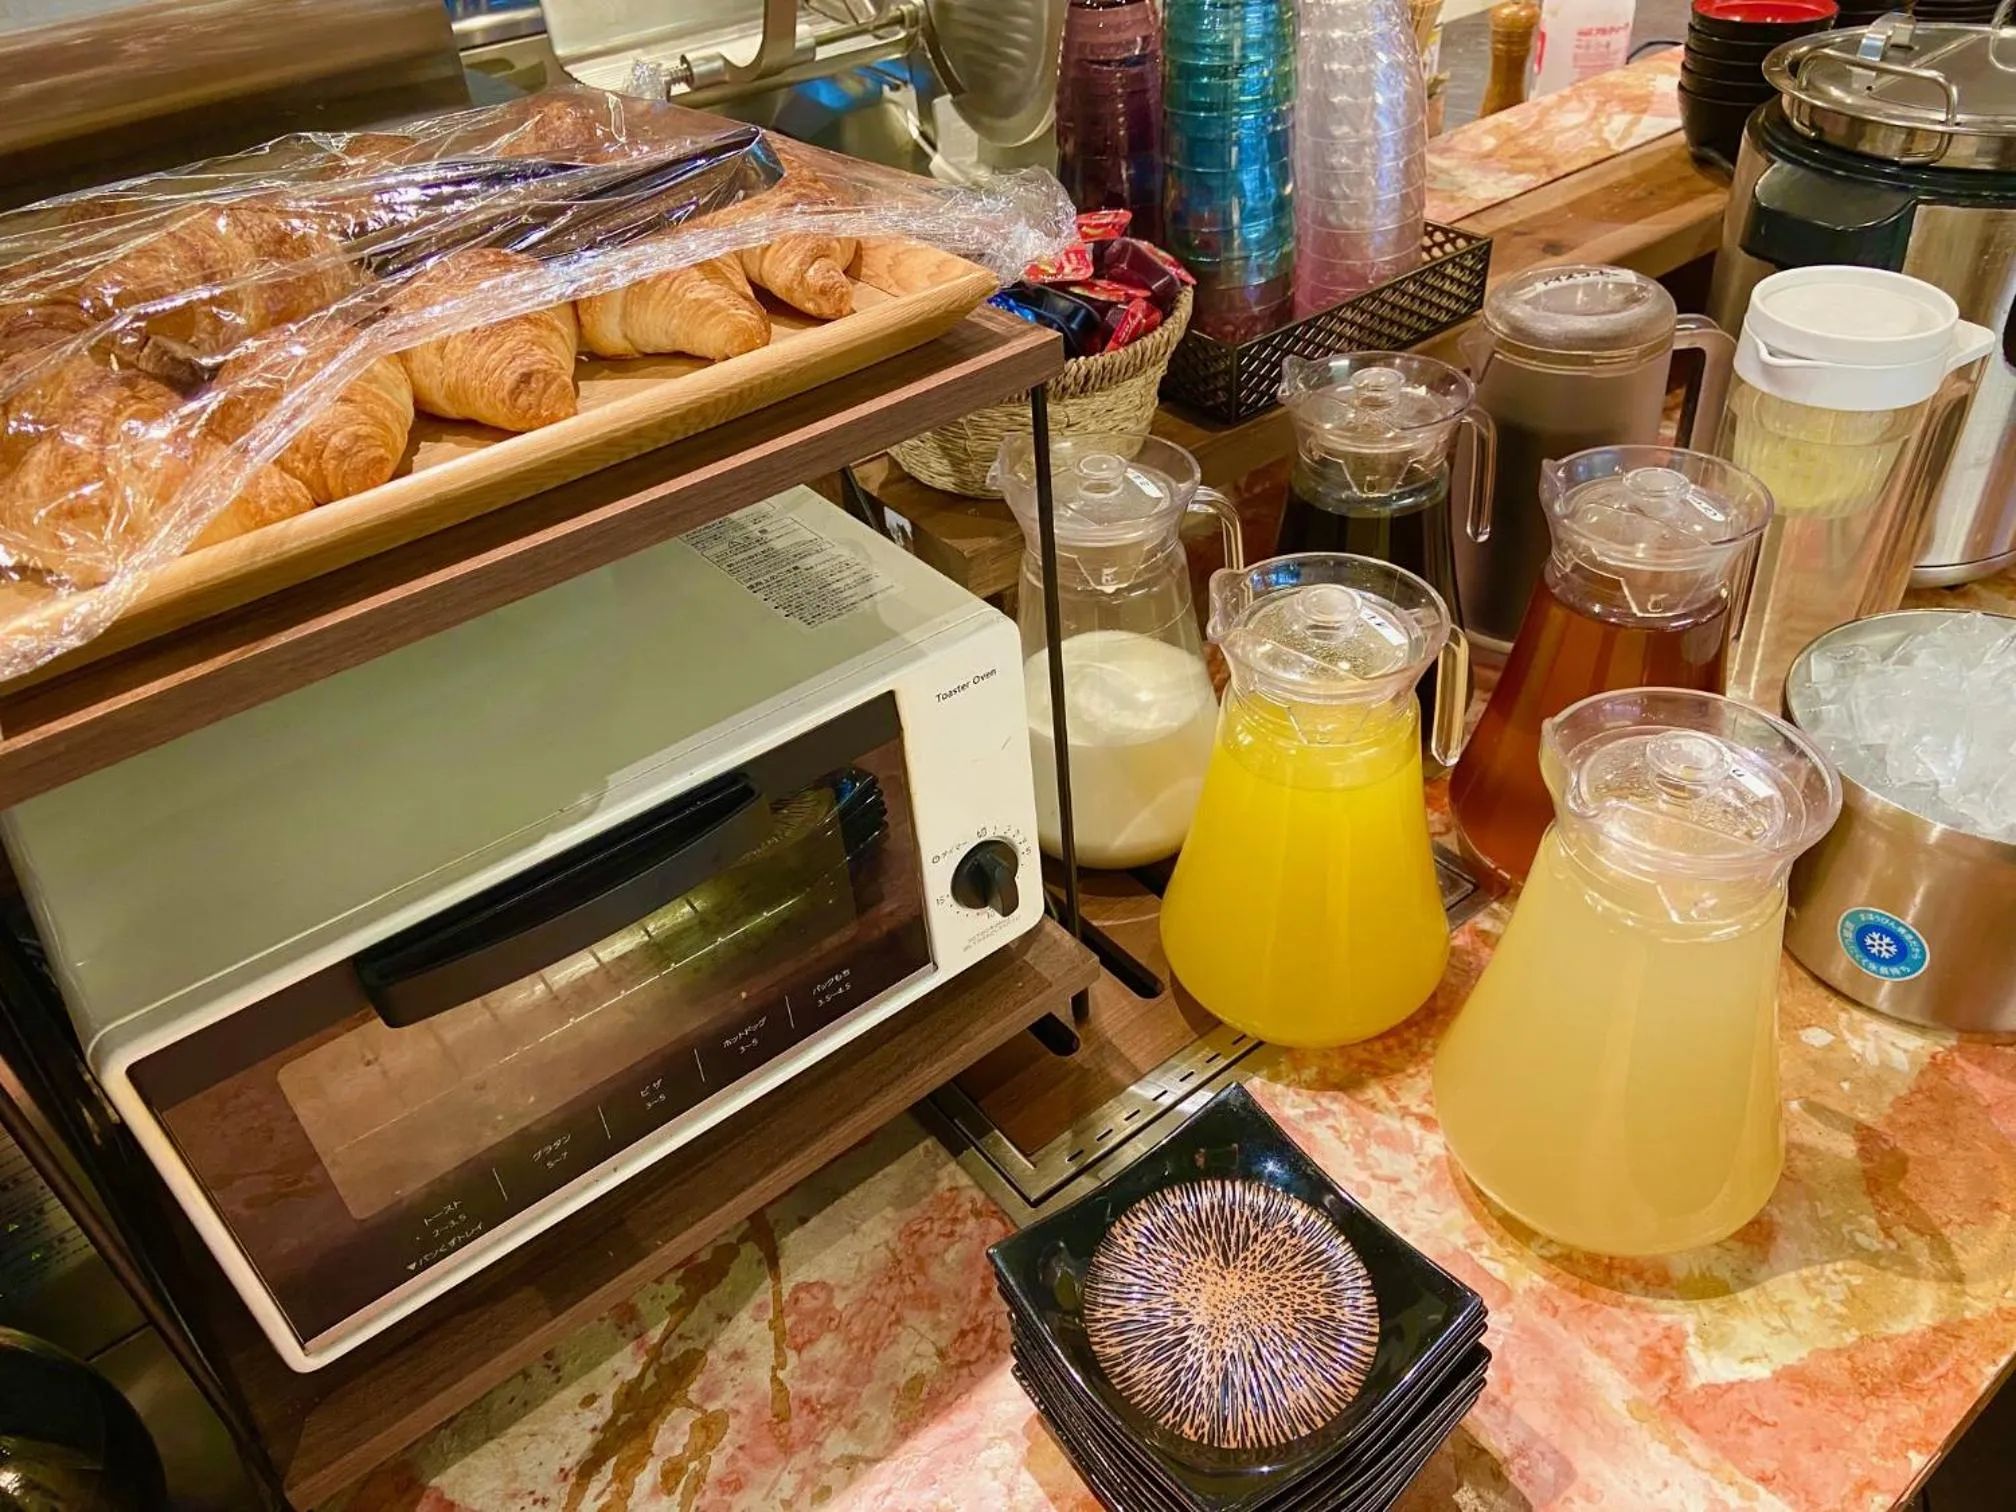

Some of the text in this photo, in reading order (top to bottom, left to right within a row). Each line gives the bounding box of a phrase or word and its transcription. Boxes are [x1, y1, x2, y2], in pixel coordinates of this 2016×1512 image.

[935, 668, 997, 703] Toaster Oven
[532, 1134, 572, 1163] グラタン
[424, 1201, 462, 1226] トースト
